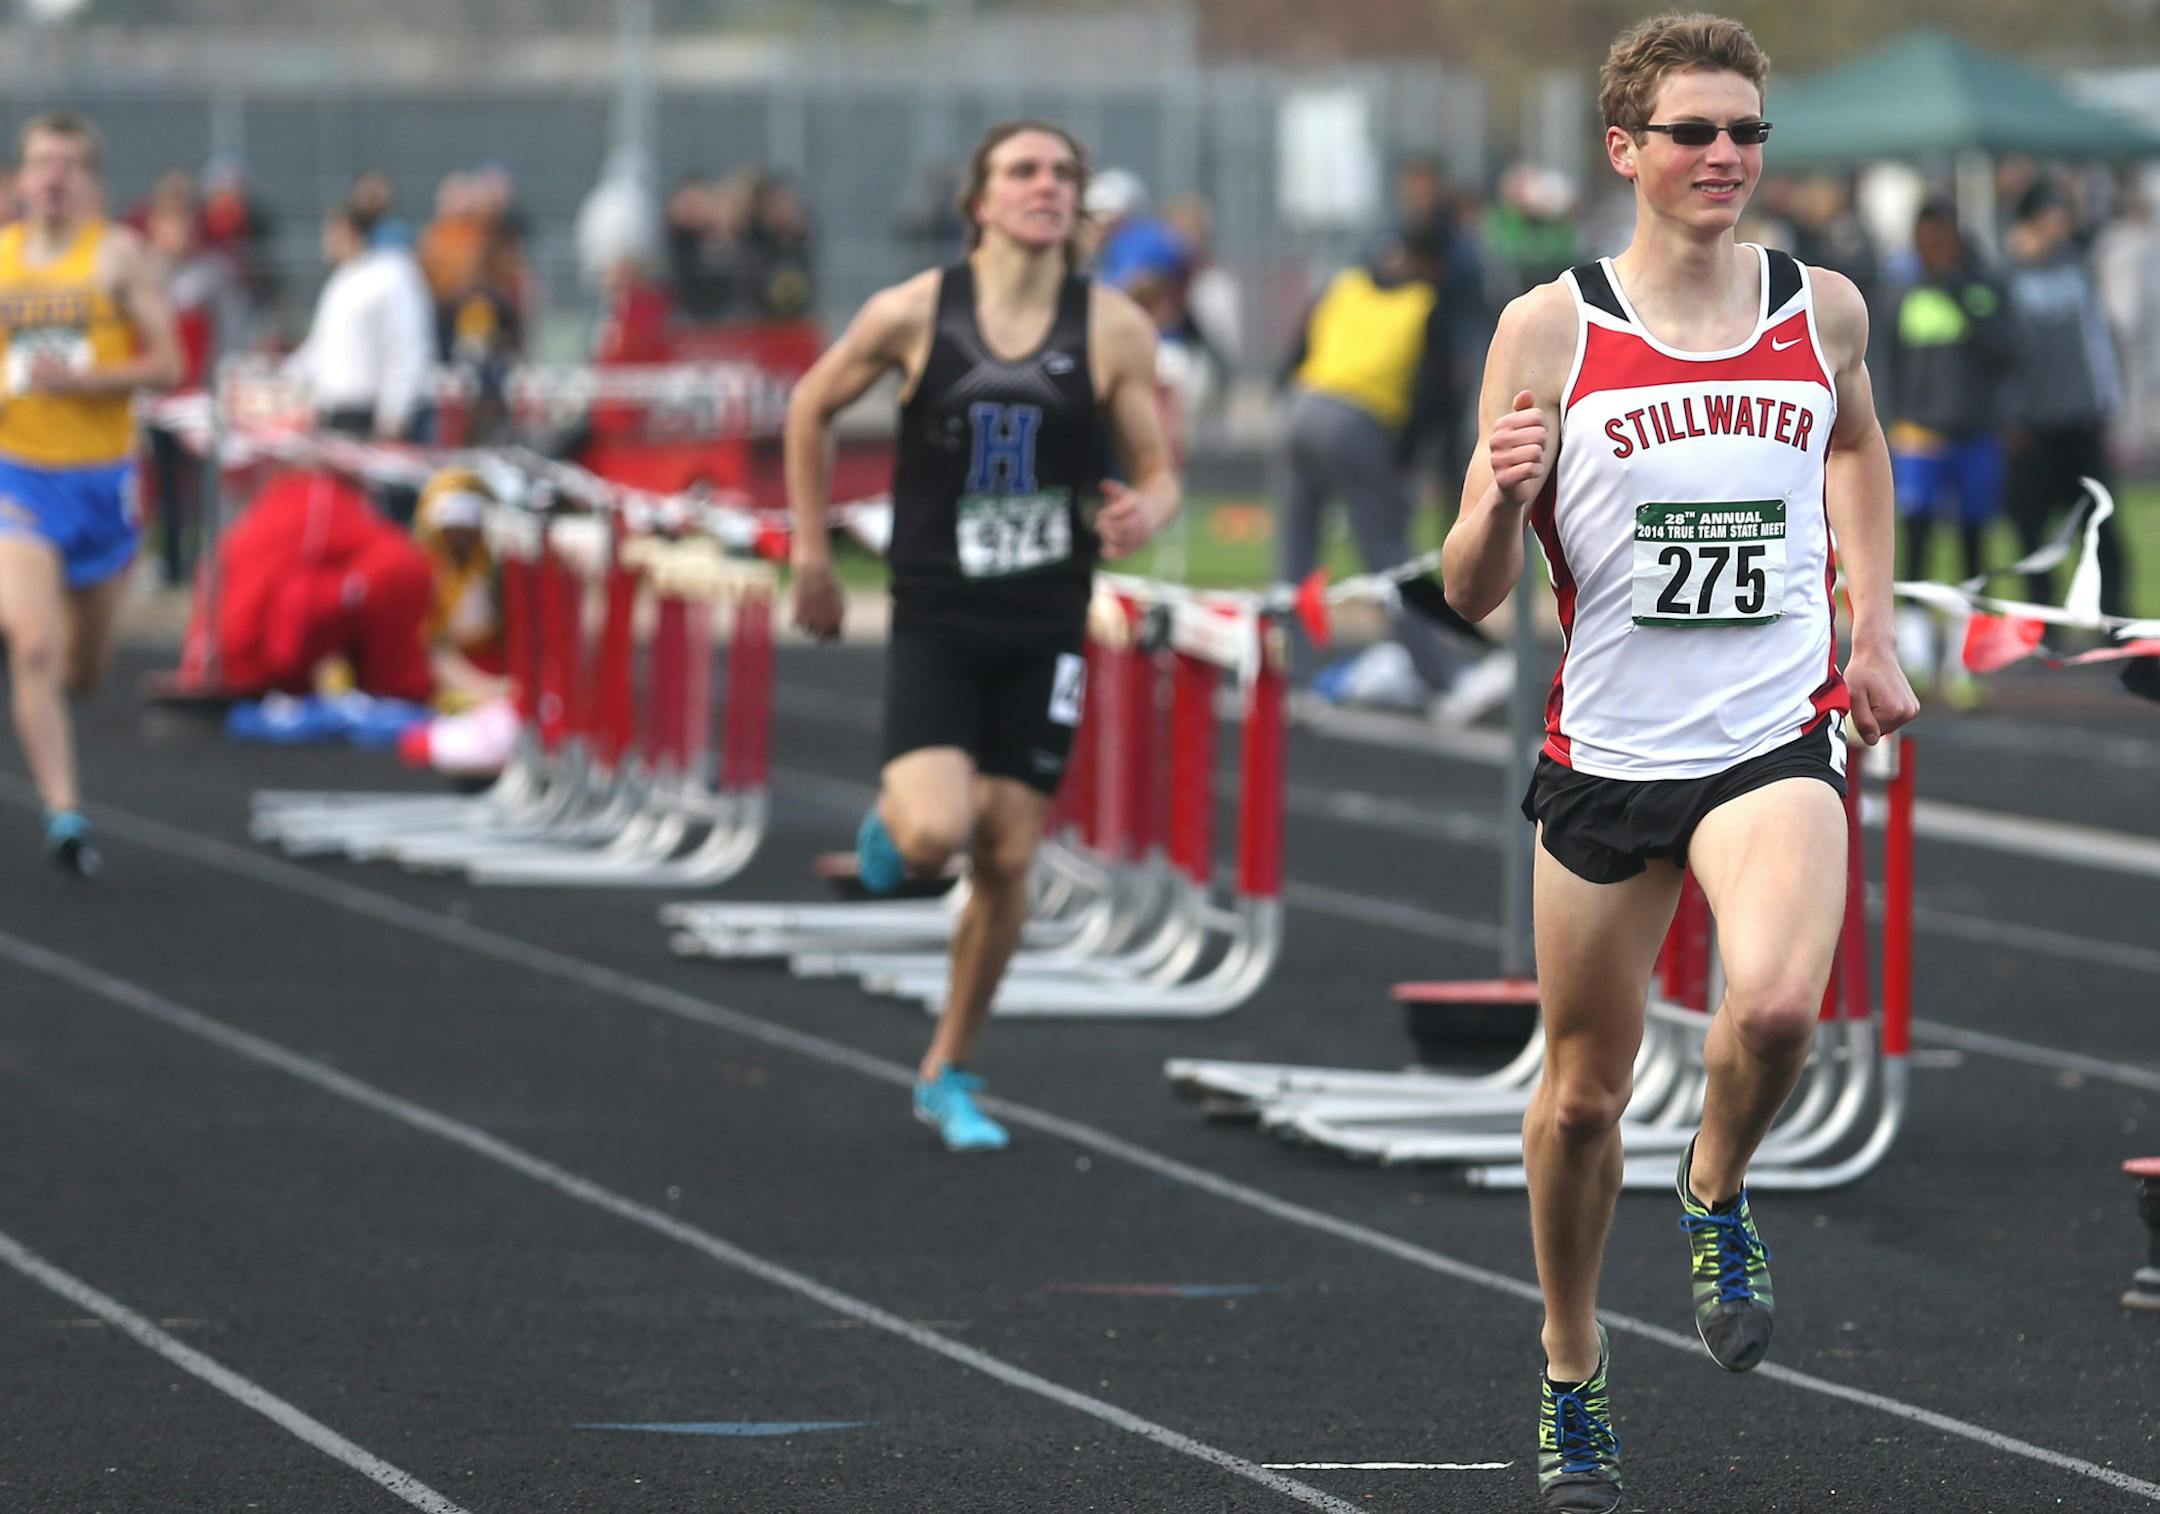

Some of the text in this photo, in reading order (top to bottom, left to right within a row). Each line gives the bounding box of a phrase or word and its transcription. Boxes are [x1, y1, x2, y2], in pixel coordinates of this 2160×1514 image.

[968, 402, 1042, 494] H
[1605, 395, 1813, 459] STILLWATER
[1637, 522, 1785, 538] 2014 TRUE TEAM STATE MEET
[1664, 511, 1763, 525] 28TH ANNUAL
[1656, 545, 1766, 614] 275
